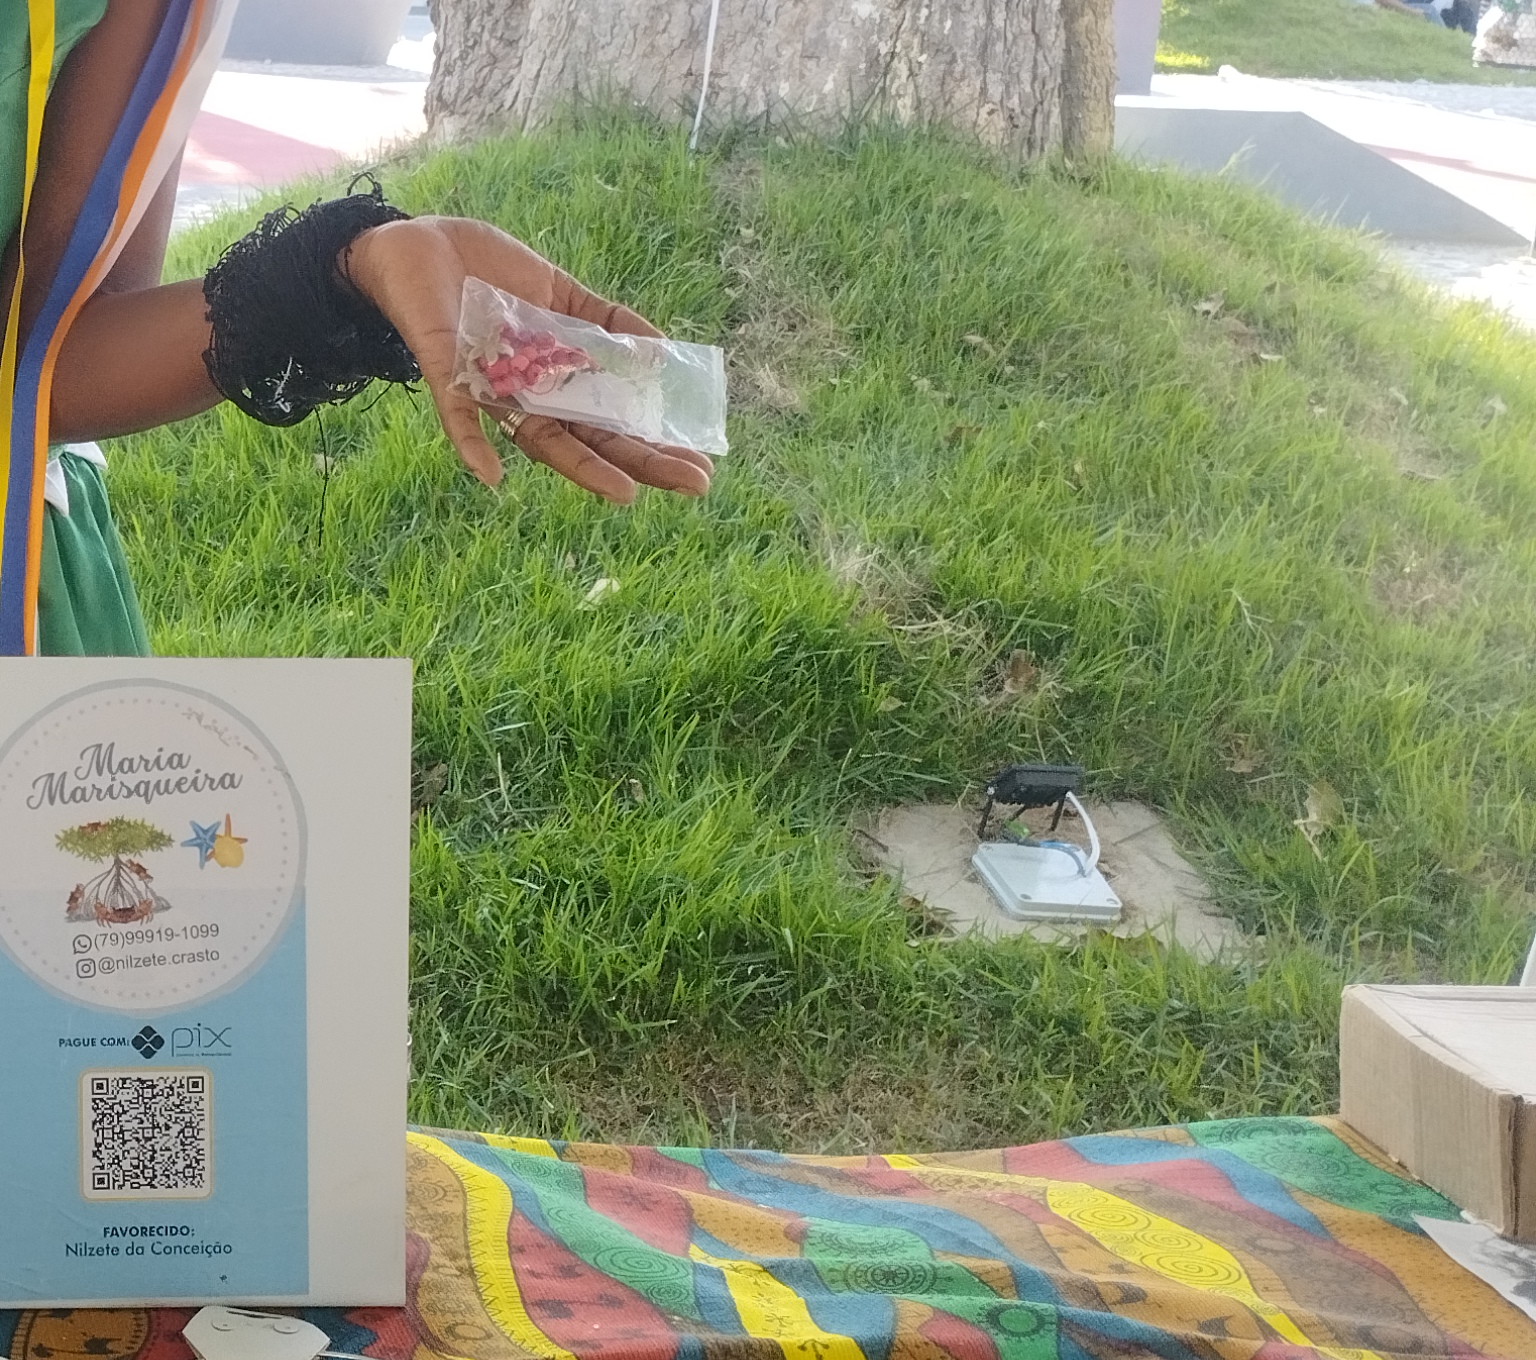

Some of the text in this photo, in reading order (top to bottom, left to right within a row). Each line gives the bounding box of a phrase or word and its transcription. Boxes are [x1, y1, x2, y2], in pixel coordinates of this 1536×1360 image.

[74, 741, 192, 781] Maria
[26, 768, 243, 810] Marisqueira
[94, 923, 220, 952] (79)99919-1099
[98, 948, 220, 975] @nilzete.crasto
[58, 1036, 98, 1048] PAGUE
[171, 1022, 233, 1058] pix
[103, 1225, 196, 1238] FAVORECIDO:
[65, 1240, 234, 1259] Nilzete da Conceição
